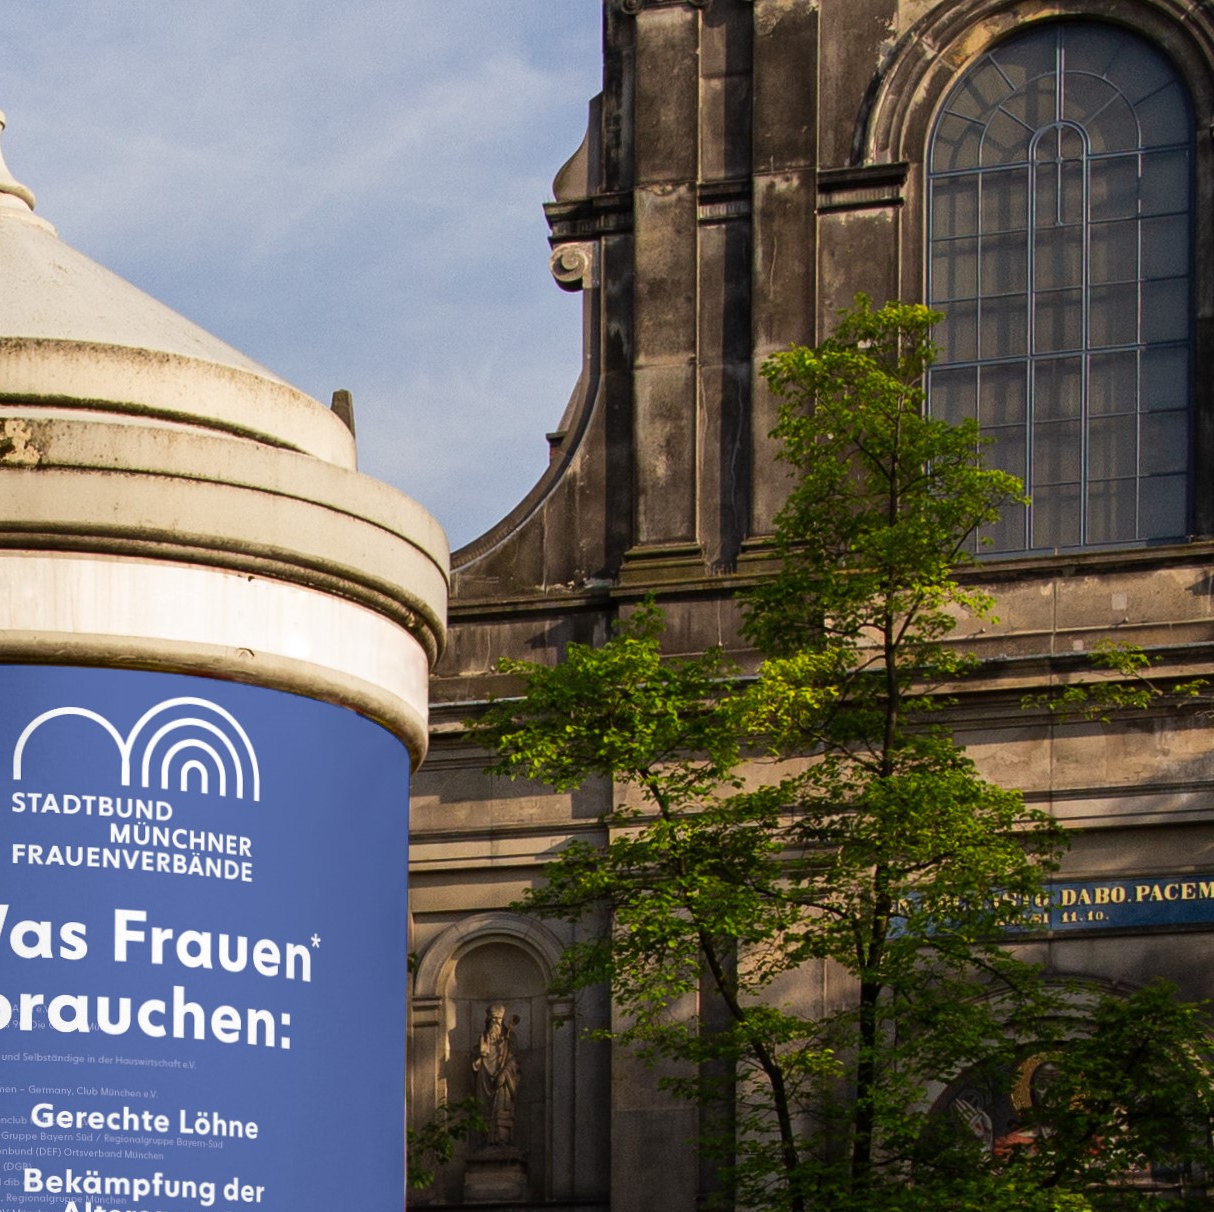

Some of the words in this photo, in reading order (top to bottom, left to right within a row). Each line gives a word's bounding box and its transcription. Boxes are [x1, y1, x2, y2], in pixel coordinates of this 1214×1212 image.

[13, 792, 172, 823] STADTBUND
[108, 822, 251, 860] MÜNCHNER
[13, 841, 252, 882] FRAUENVERBÄNDE
[1136, 881, 1214, 902] PACEM
[23, 1053, 85, 1064] Selbständige
[88, 1055, 95, 1063] in
[98, 1056, 113, 1064] der
[116, 1056, 181, 1068] Hauswirtschaft
[183, 1061, 197, 1069] e.V.
[77, 1087, 98, 1095] Club
[101, 1088, 141, 1097] München
[144, 1090, 159, 1098] e.V.
[32, 1103, 169, 1132] Gerechte
[180, 1110, 258, 1139] Löhne
[24, 1168, 215, 1209] Bekämpfung
[224, 1178, 264, 1202] der
